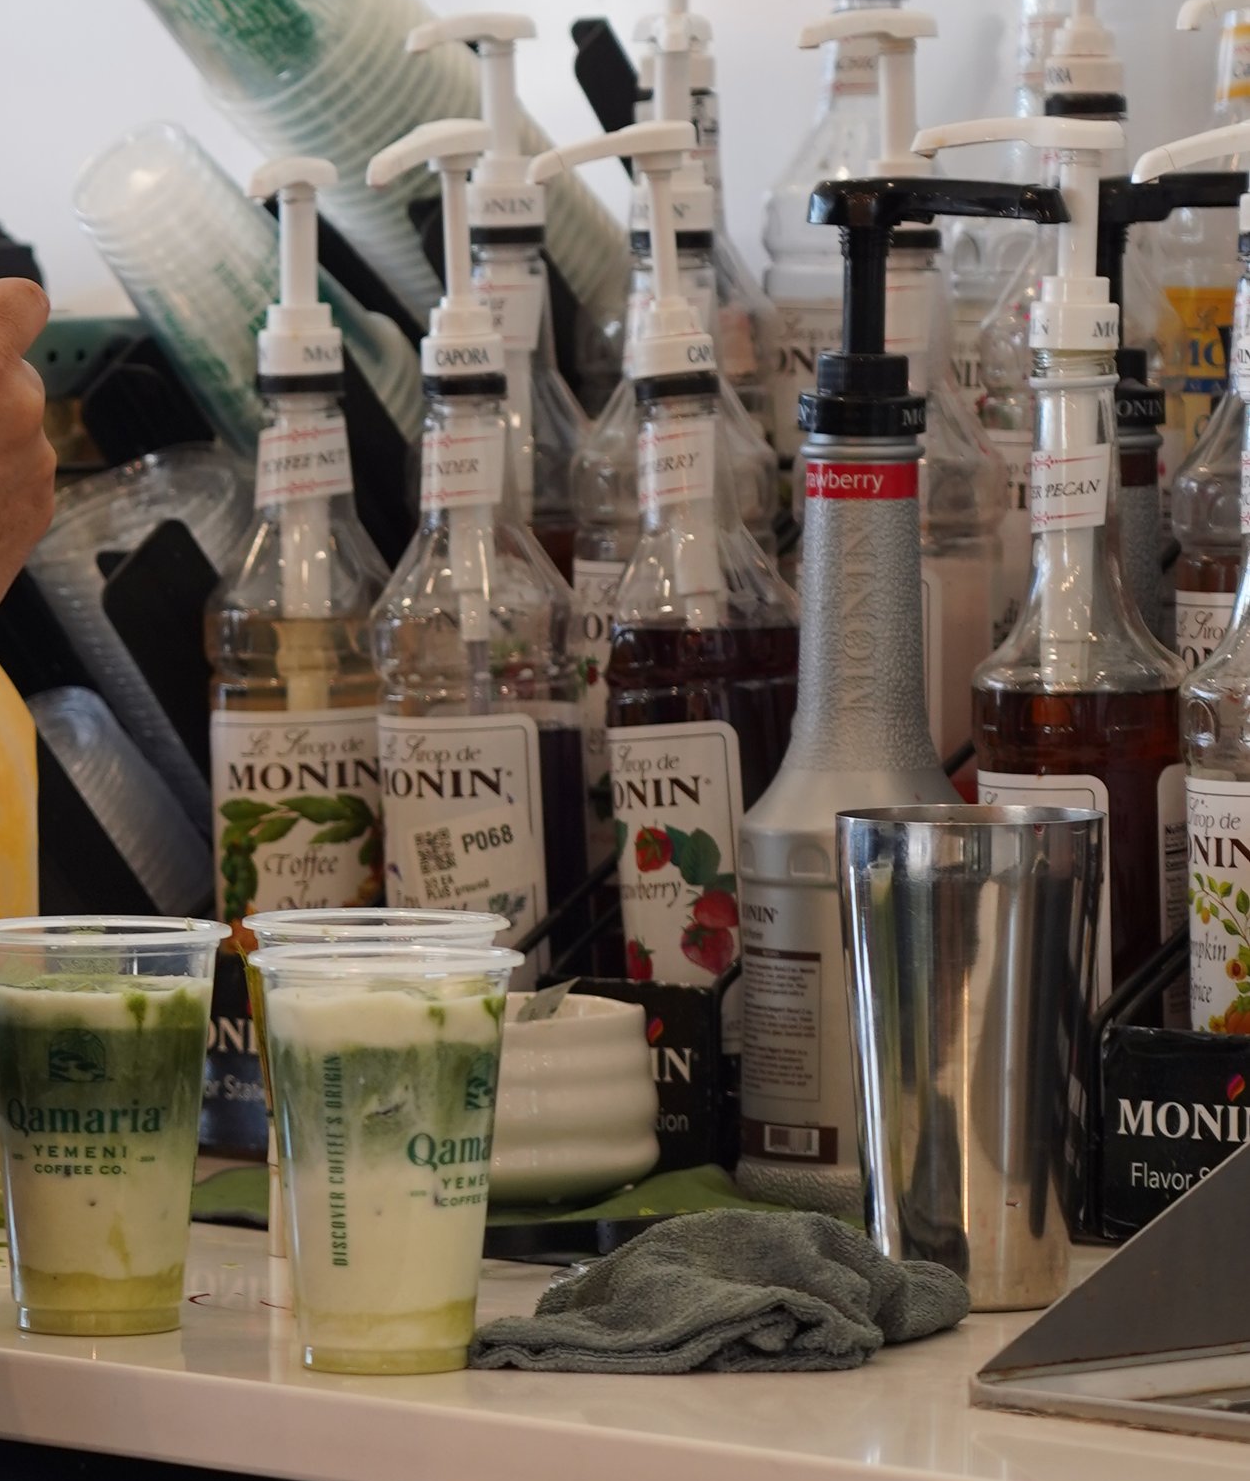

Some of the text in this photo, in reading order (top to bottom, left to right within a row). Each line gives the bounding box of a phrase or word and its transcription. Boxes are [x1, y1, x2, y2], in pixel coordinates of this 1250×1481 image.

[435, 345, 490, 367] CAPORA
[1045, 478, 1101, 499] PECAN
[841, 520, 879, 714] MONIN
[456, 745, 483, 763] de
[656, 752, 681, 771] de
[227, 755, 382, 793] MONIN
[1219, 812, 1241, 831] de
[461, 823, 514, 855] P068
[263, 844, 340, 879] Toffee
[7, 1097, 161, 1138] Qamaria
[33, 1144, 128, 1159] YEMENI
[323, 1054, 349, 1267] DISCOVER COFFEE'S ORIGIN
[34, 1163, 128, 1176] COFFEE CO.
[1130, 1160, 1193, 1191] Flavor
